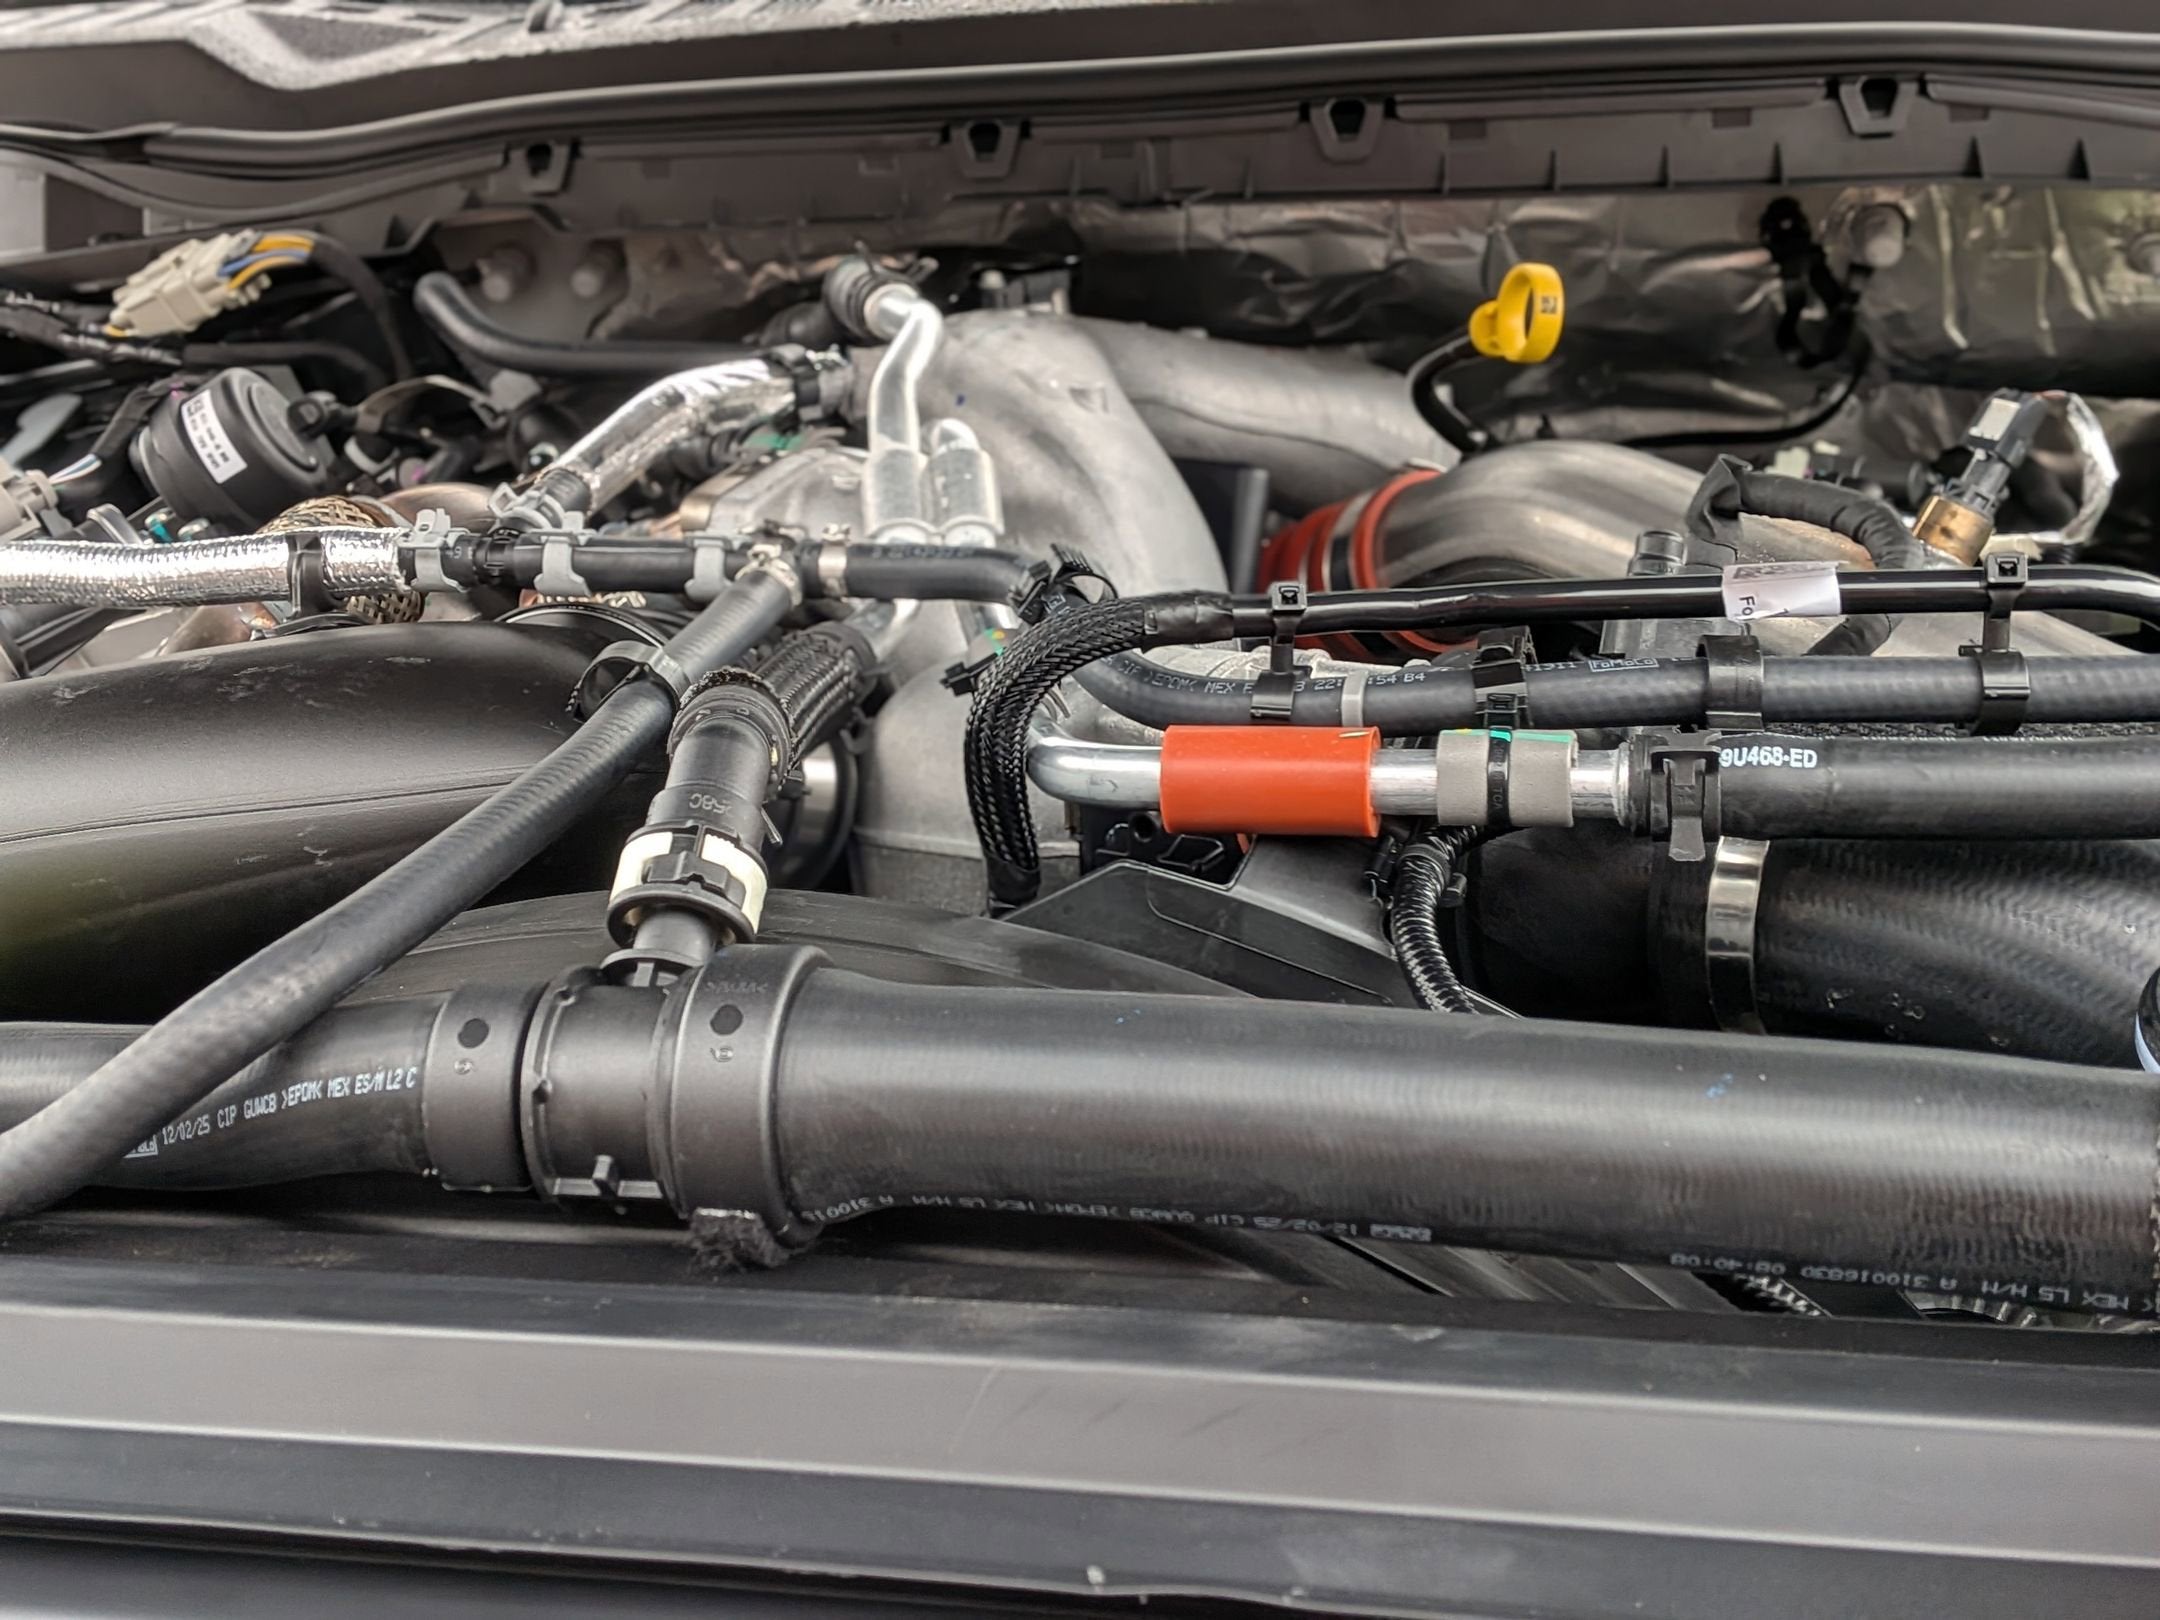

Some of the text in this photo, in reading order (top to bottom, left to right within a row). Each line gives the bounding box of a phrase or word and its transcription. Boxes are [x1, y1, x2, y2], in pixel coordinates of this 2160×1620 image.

[1739, 596, 1755, 616] Fo
[1204, 681, 1236, 694] MEX
[162, 1113, 211, 1145] 12/02/25
[217, 1104, 237, 1129] CIP
[328, 1076, 352, 1098] MEX
[1669, 1253, 1787, 1277] 08:40:08
[2081, 1291, 2130, 1310] MEX
